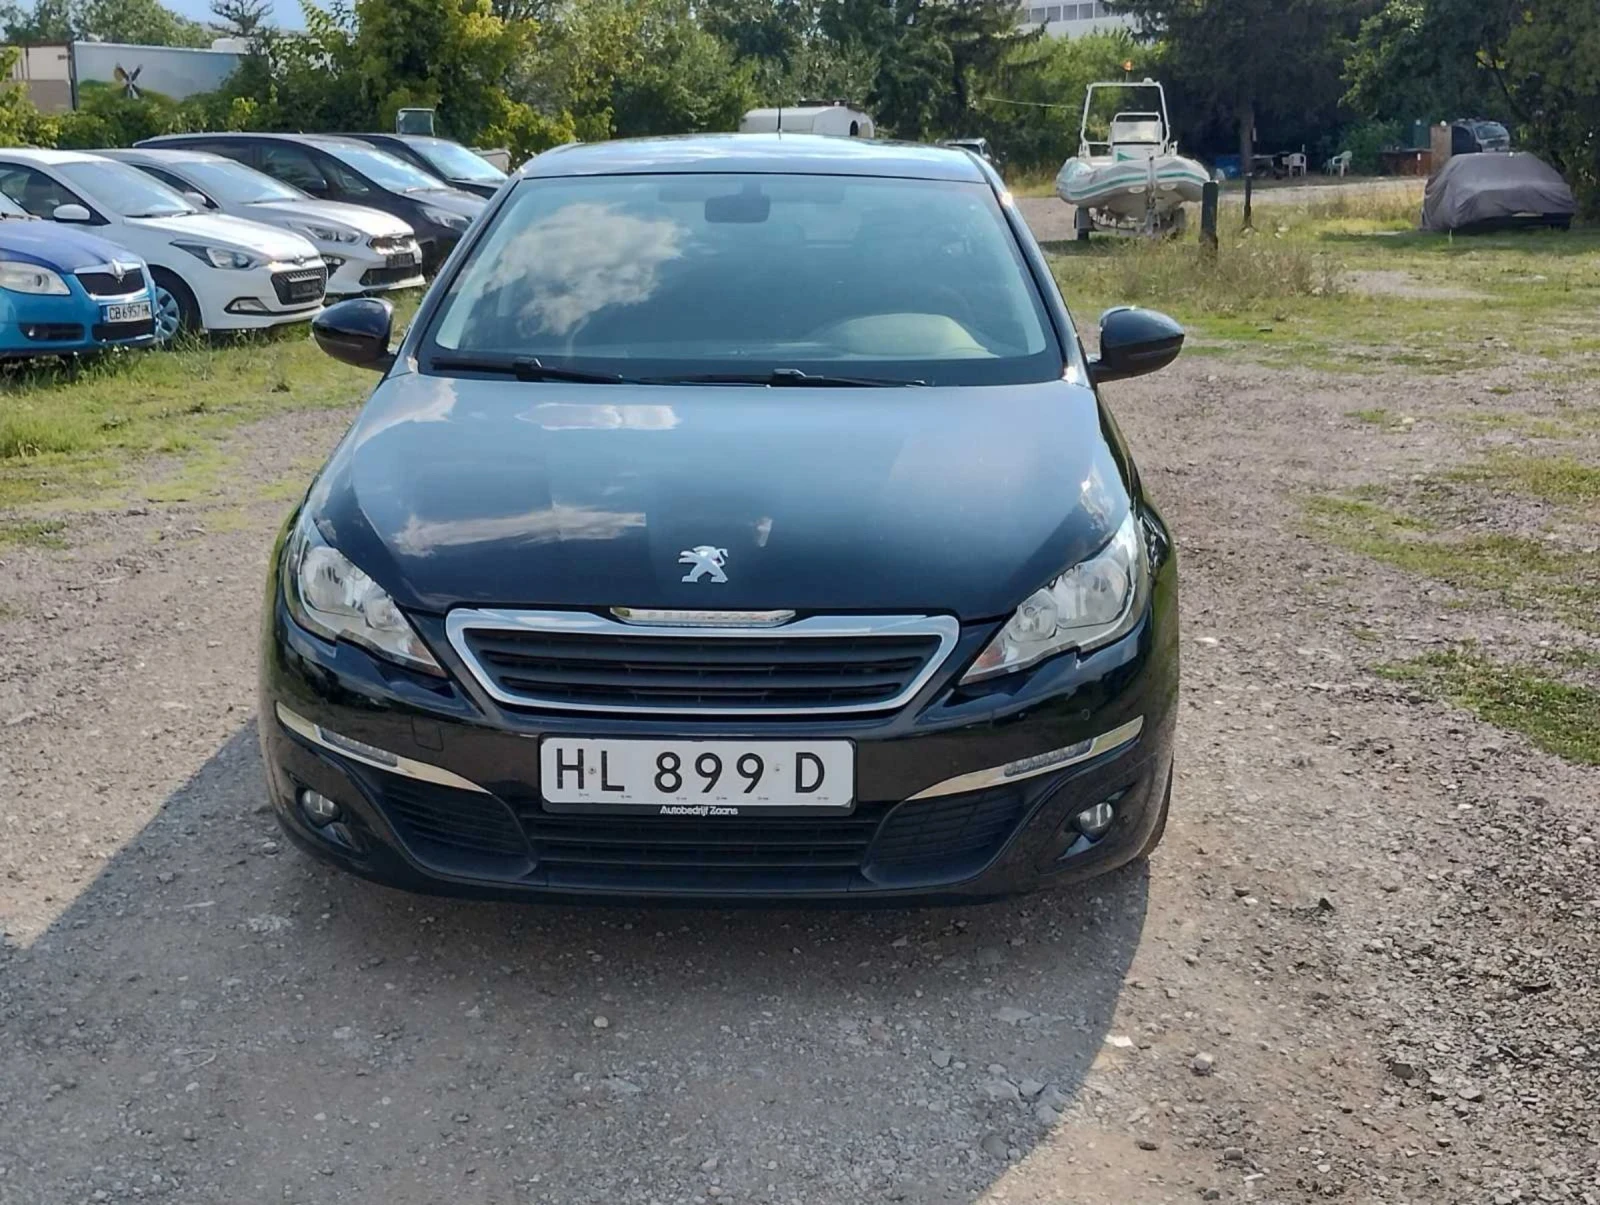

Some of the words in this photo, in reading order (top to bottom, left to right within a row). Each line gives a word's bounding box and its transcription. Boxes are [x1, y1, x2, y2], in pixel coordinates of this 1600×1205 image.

[109, 306, 121, 320] CB
[556, 748, 625, 792] HL
[654, 751, 765, 794] 899
[795, 751, 825, 794] D
[660, 805, 709, 817] Autobedrijf
